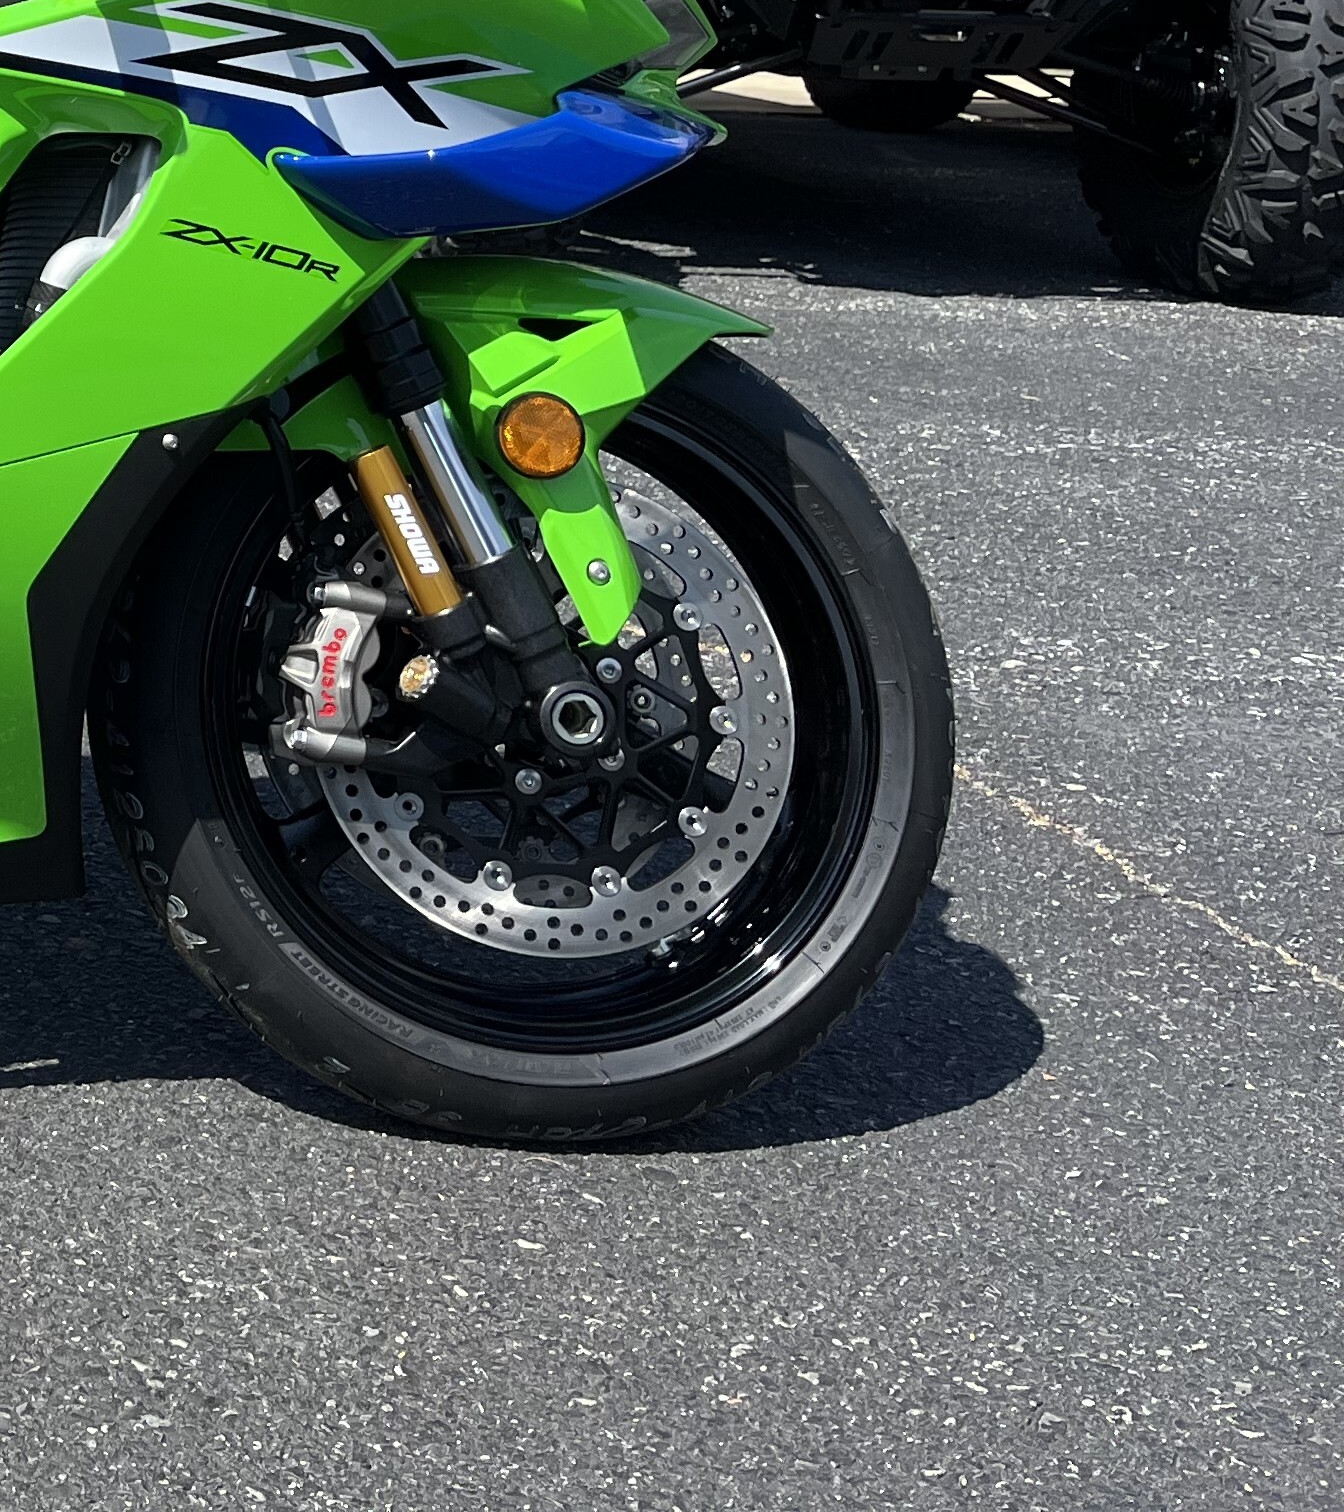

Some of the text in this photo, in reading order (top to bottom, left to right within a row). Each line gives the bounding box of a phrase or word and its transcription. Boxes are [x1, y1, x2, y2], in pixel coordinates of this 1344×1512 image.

[161, 217, 341, 283] ZX-10R
[383, 492, 442, 577] SHOWA
[317, 626, 348, 720] brembo
[290, 949, 414, 1039] RACING STREET
